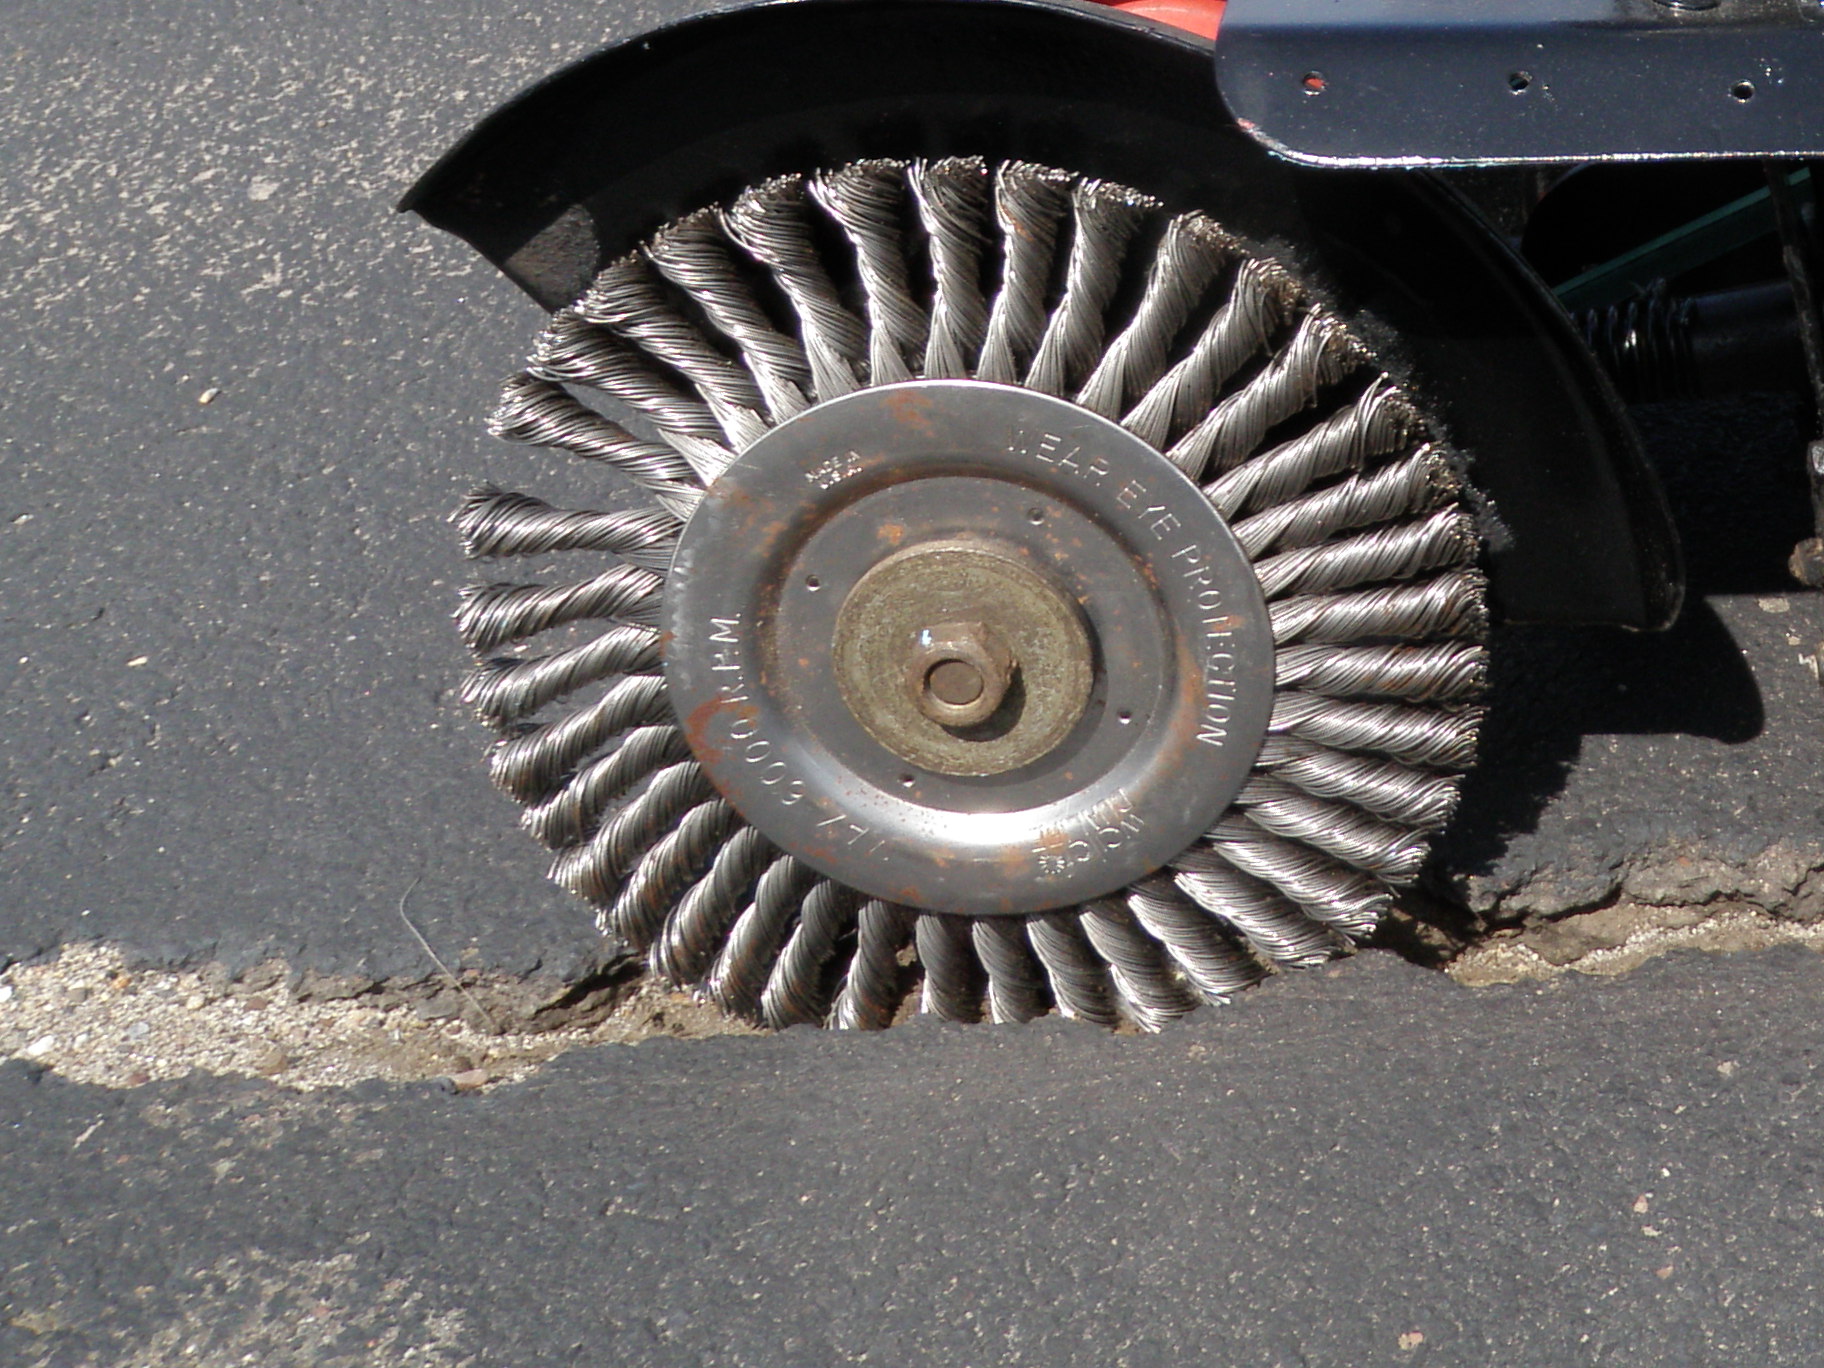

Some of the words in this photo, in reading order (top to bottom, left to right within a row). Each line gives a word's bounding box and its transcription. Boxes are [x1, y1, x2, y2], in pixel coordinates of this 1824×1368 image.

[1007, 422, 1111, 487] WEAR
[1116, 479, 1182, 541] EYE
[1170, 544, 1237, 747] PROTECTION
[708, 612, 751, 704] R.P.M.
[729, 717, 806, 806] 6000
